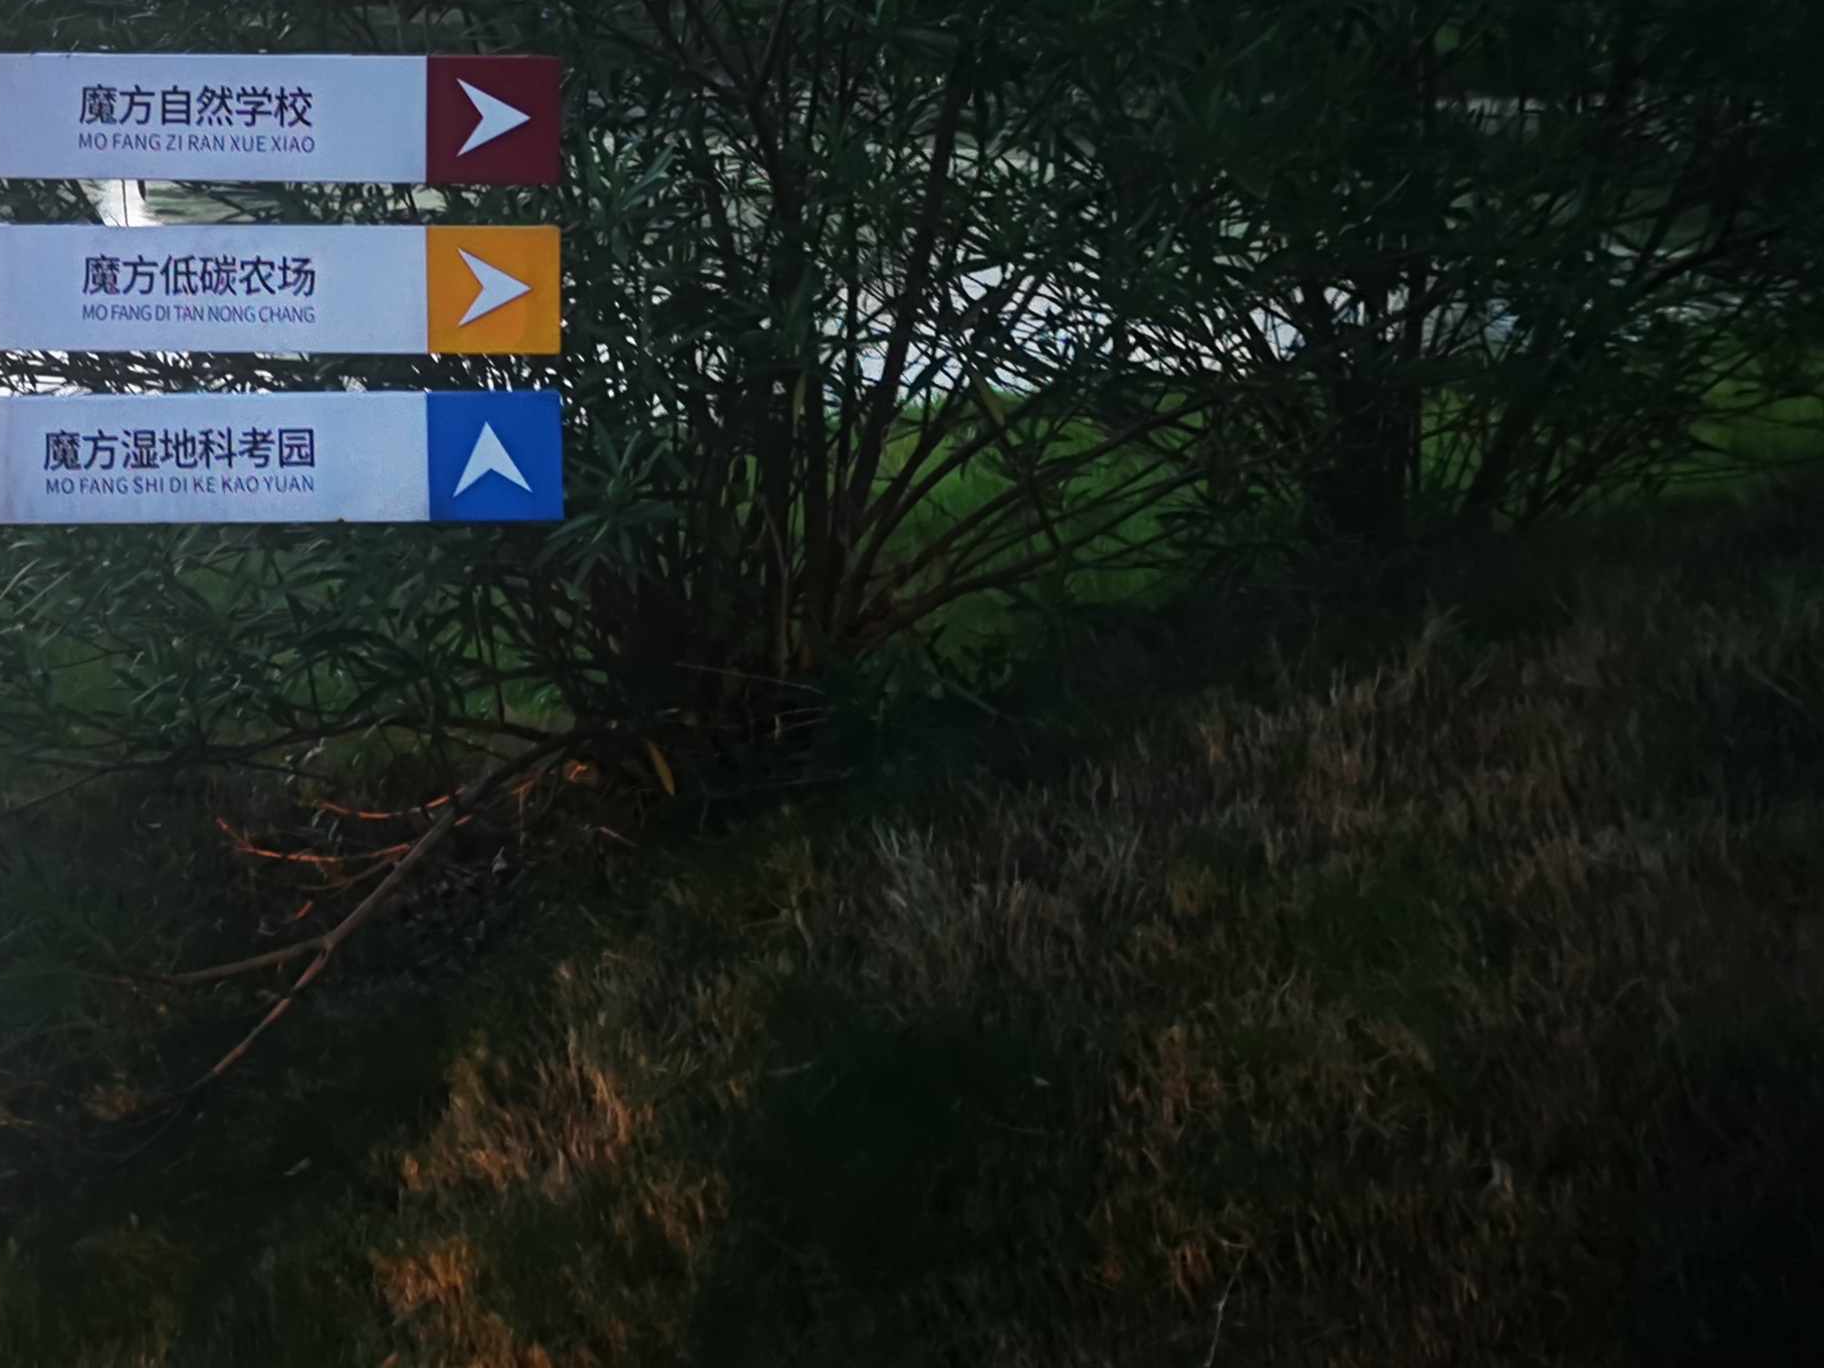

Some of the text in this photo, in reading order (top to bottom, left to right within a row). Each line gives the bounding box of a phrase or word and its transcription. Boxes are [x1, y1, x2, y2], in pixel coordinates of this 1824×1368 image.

[78, 83, 314, 128] 魔方自然学校
[78, 132, 316, 154] MO FANG ZI RAN XUE XIAO
[82, 253, 316, 297] 魔方低碳农场
[81, 303, 316, 324] MO FANG DI TAN NONG CHANG
[43, 426, 315, 472] 魔方湿地科考园
[45, 474, 315, 496] MO FANG SHI DI KE KAO YUAN
